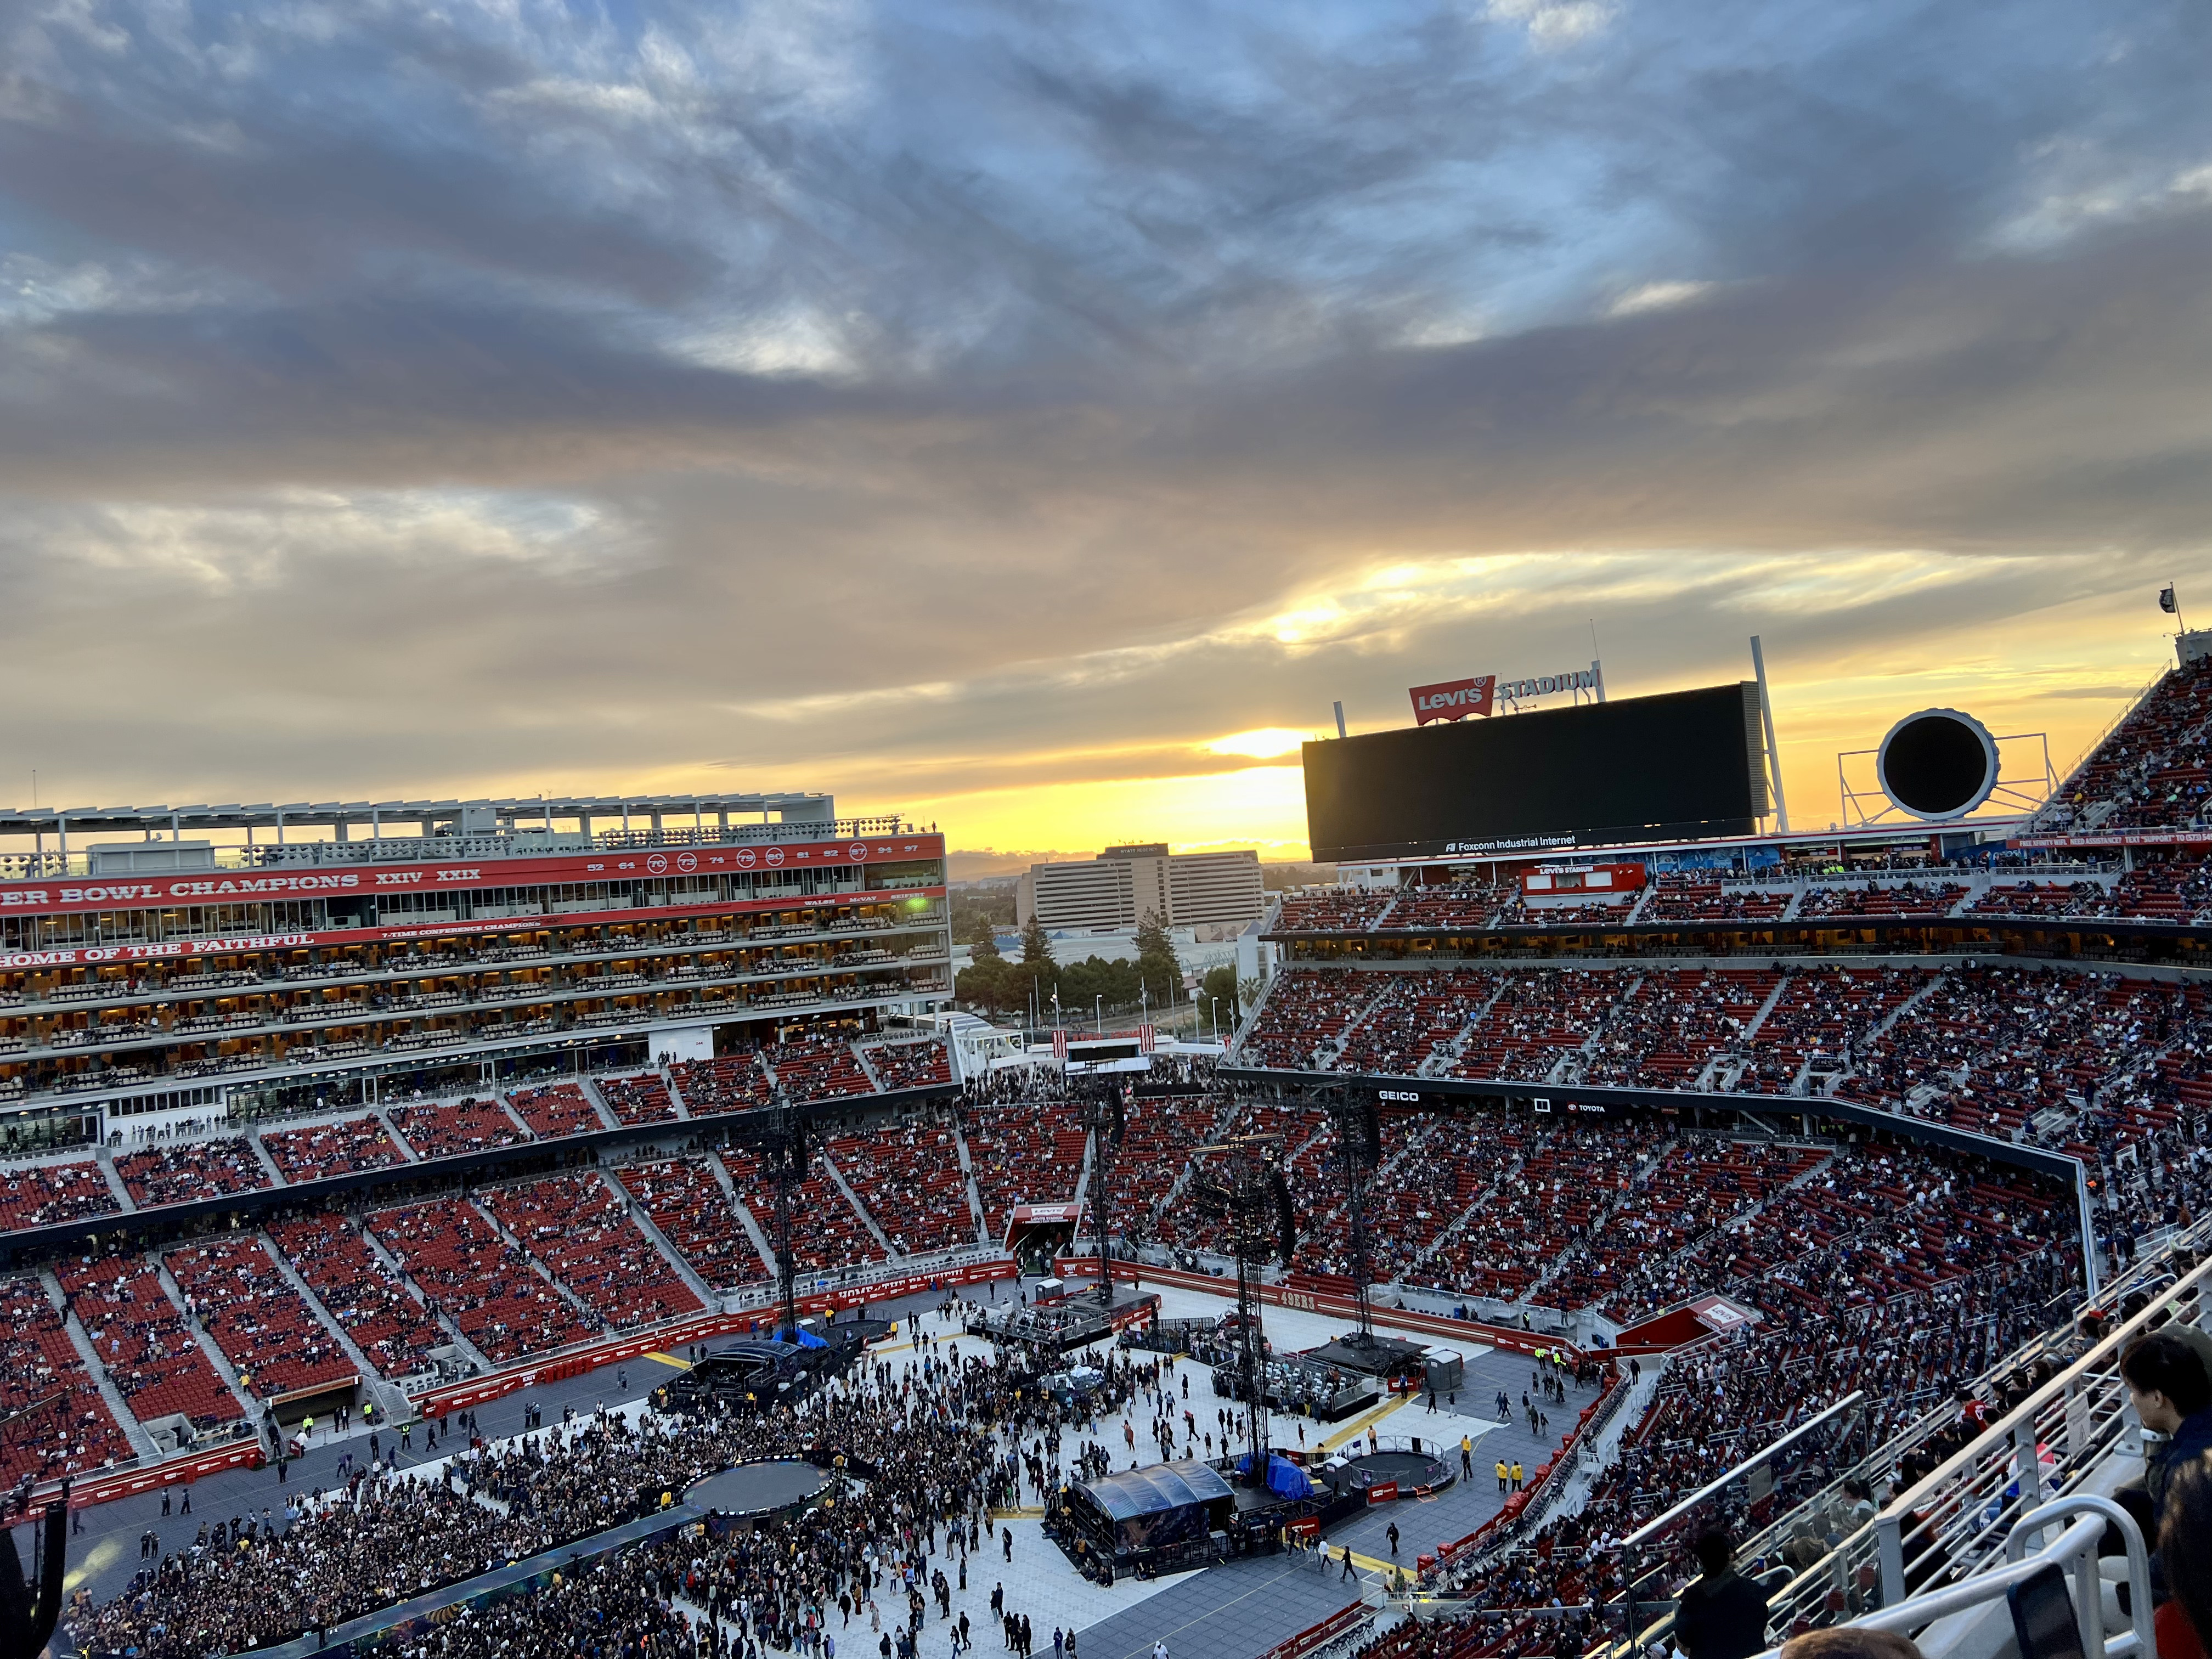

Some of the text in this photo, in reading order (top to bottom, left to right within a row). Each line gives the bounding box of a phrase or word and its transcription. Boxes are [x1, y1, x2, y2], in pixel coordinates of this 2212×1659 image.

[1498, 669, 1600, 700] STADIUM
[1458, 842, 1495, 851] Foxconn
[1497, 837, 1538, 849] Industrial
[1540, 835, 1576, 846] Internet
[587, 863, 605, 872] 52
[618, 861, 635, 870] 64
[650, 860, 665, 868] 70
[59, 884, 162, 903] BOWL
[170, 874, 359, 897] CHAMPIONS
[375, 872, 423, 885] XXIV
[436, 868, 481, 882] XXIX
[382, 921, 541, 939] 7-TIME CONFERENCE CHAMPIONS
[84, 947, 121, 961] OF
[127, 943, 182, 958] THE
[191, 934, 314, 953] FAITHFUL
[1379, 1091, 1419, 1102] GEICO
[1281, 1291, 1315, 1310] 49ERS
